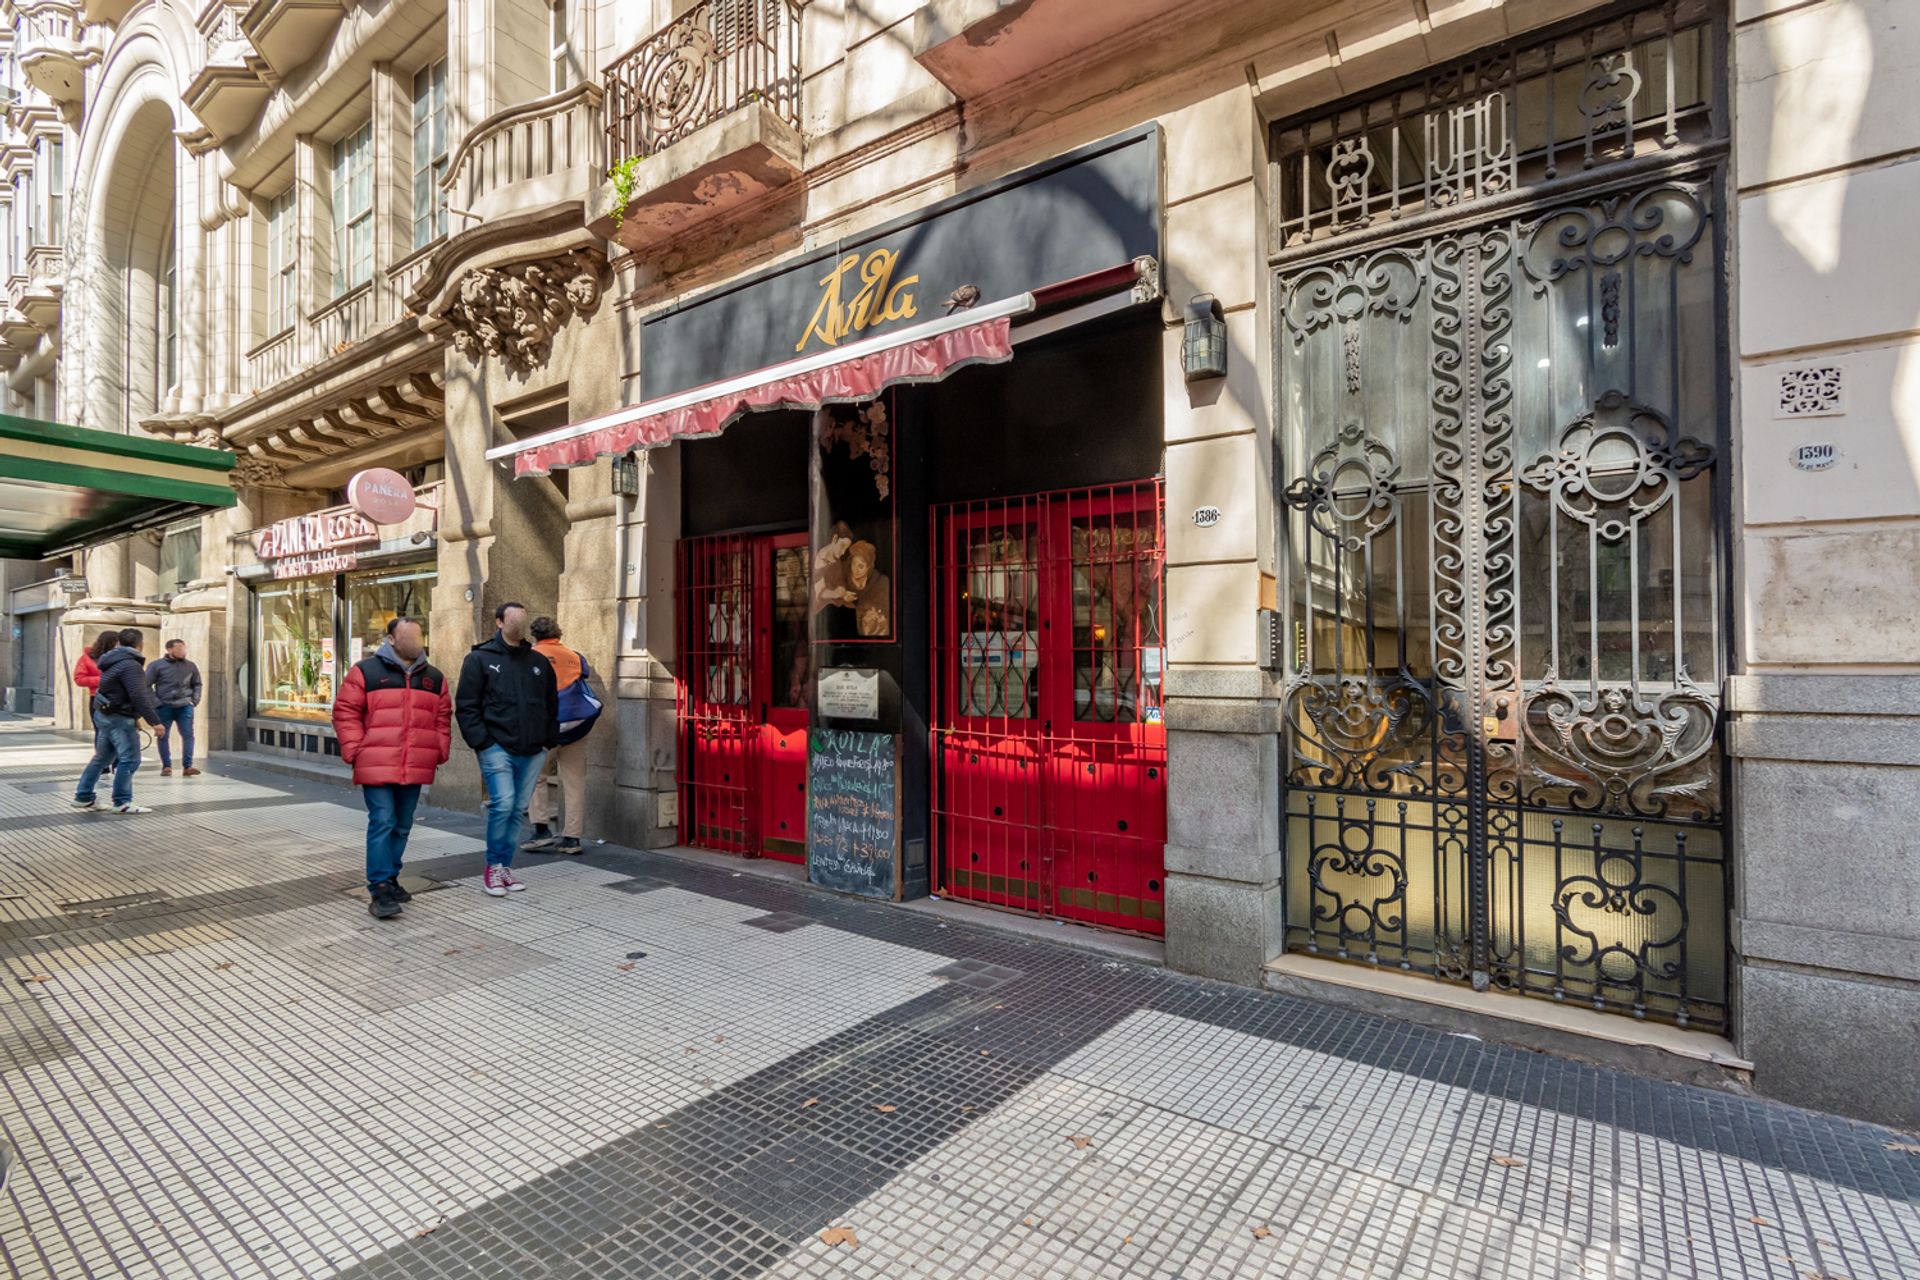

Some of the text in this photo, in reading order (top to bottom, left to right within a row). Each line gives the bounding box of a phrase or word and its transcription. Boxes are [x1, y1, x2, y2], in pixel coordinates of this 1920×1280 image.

[1799, 445, 1833, 460] 1390
[364, 481, 408, 500] PANERA
[1195, 509, 1218, 524] 1386
[272, 512, 325, 557] PANERA
[327, 513, 370, 541] ROSA
